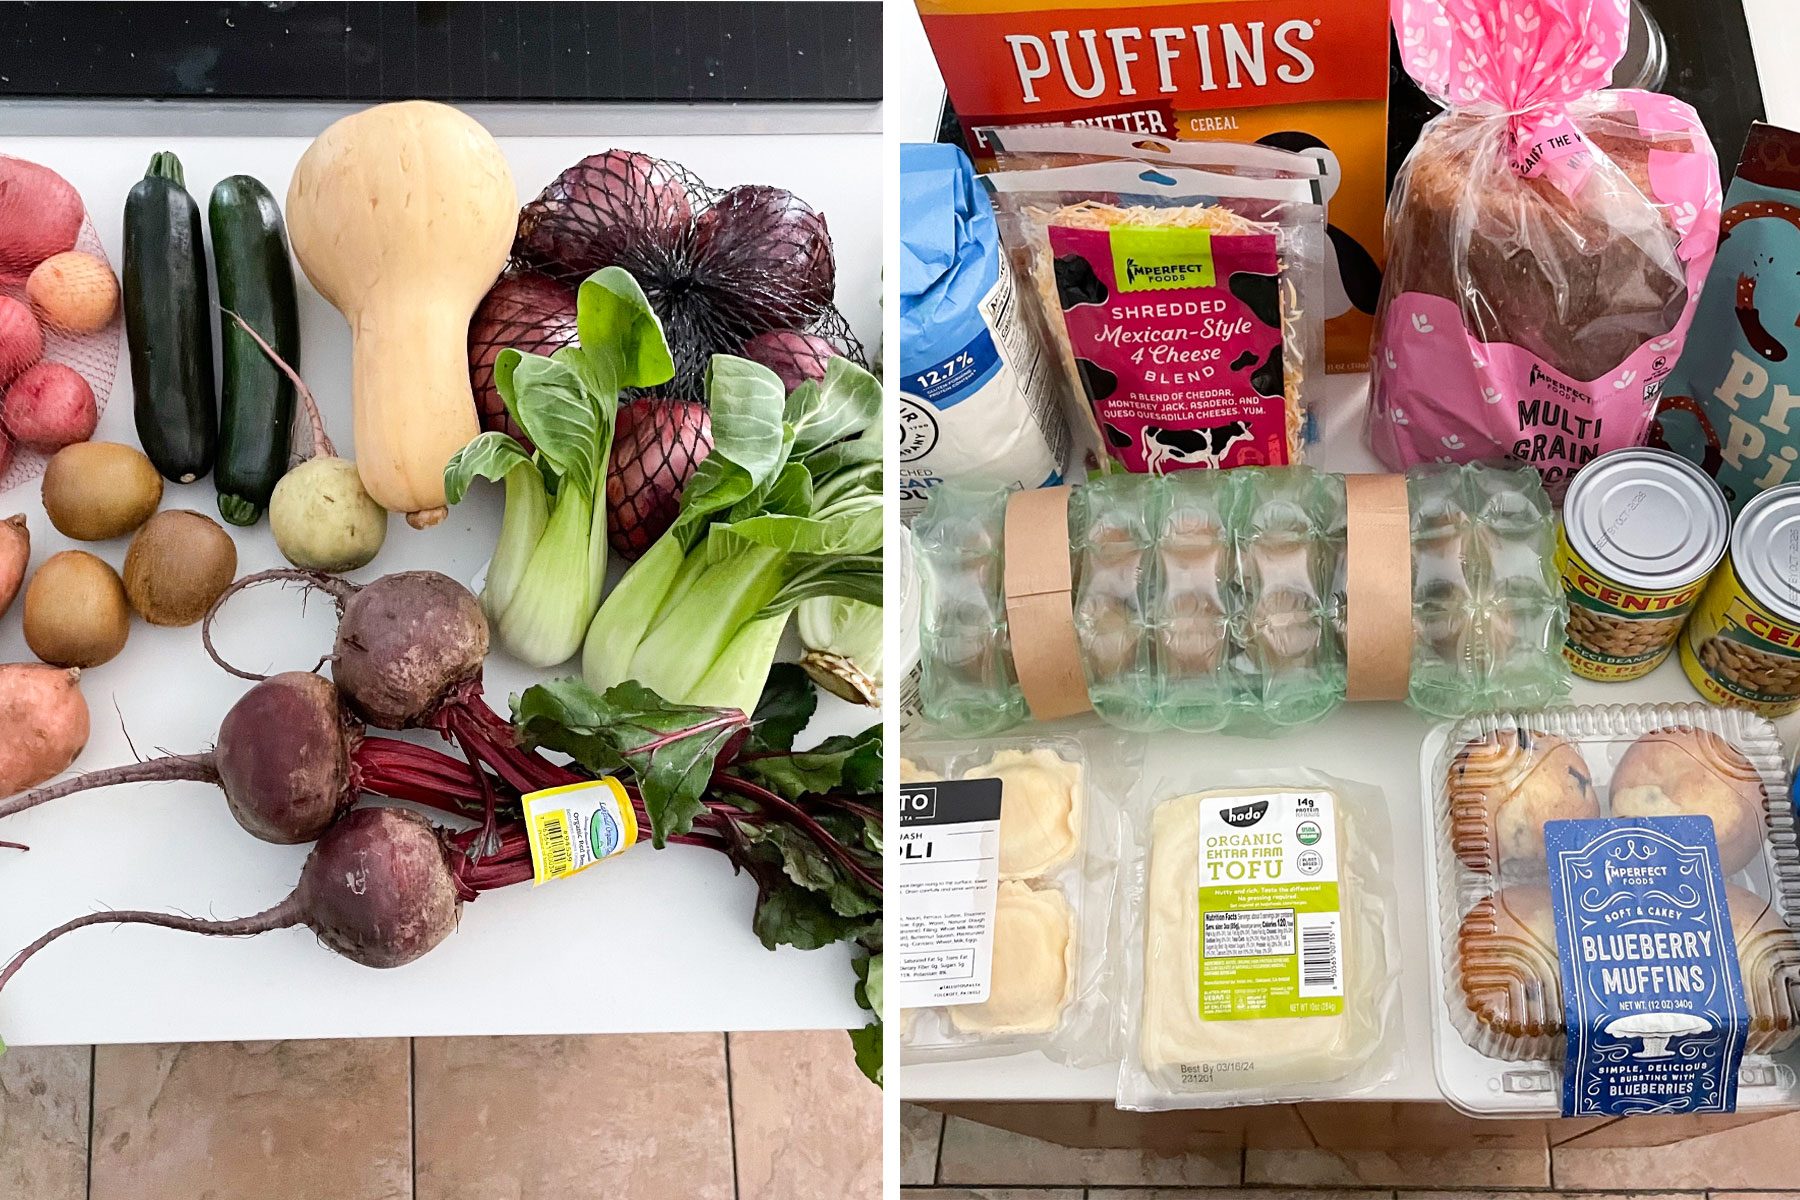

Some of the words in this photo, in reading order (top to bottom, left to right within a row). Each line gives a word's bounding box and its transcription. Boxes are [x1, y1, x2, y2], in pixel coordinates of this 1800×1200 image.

[1005, 20, 1315, 103] PUFFINS
[1190, 116, 1239, 132] CEREAL
[1548, 134, 1572, 148] THE
[1148, 274, 1185, 282] FOODS
[1112, 300, 1226, 319] SHREDDED
[1094, 317, 1252, 347] Mexican-Style
[1130, 348, 1144, 365] 4
[1149, 345, 1221, 364] Cheese
[917, 351, 974, 388] 12.7%
[1144, 366, 1214, 384] BLEND
[929, 386, 952, 398] PROTEIN
[1130, 392, 1137, 400] A
[1139, 392, 1170, 401] BLEND
[1172, 392, 1184, 400] OF
[1547, 384, 1576, 403] FOODS
[1108, 400, 1158, 410] MONTEREY
[1240, 397, 1259, 405] AND
[1104, 410, 1135, 418] QUESO
[1137, 409, 1194, 420] QUESADILLA
[1518, 400, 1602, 440] MULTI
[1512, 434, 1600, 464] GRAIN
[1578, 574, 1696, 611] CENTO
[1574, 646, 1600, 662] CECI
[1606, 655, 1650, 664] BEANS
[1728, 684, 1758, 700] CECI
[1298, 798, 1314, 808] 14g
[1228, 807, 1261, 822] hodo
[573, 812, 582, 838] Organic
[1206, 833, 1282, 848] ORGANIC
[900, 842, 932, 859] LI
[1206, 848, 1248, 860] EXTRA
[1252, 847, 1283, 858] FIRM
[1208, 860, 1284, 880] TOFU
[1226, 912, 1237, 920] Facts
[1604, 910, 1631, 922] SOFT
[1636, 907, 1644, 916] &
[1648, 908, 1682, 920] CAKEY
[1582, 931, 1712, 962] BLUEBERRY
[1602, 966, 1705, 995] MUFFINS
[1619, 1002, 1633, 1010] NET
[1634, 1001, 1646, 1010] WT.
[1648, 1000, 1660, 1010] (12
[1661, 1000, 1674, 1010] OZ)
[1675, 1000, 1692, 1010] 340g
[1180, 1064, 1200, 1073] Best
[1202, 1064, 1214, 1074] By
[1216, 1062, 1254, 1072] 03/16/24
[1598, 1065, 1642, 1074] SIMPLE,
[1648, 1062, 1708, 1072] DELICIOUS
[1182, 1074, 1214, 1083] 231201
[1620, 1074, 1670, 1082] BURSTING
[1672, 1073, 1695, 1081] WITH
[1609, 1082, 1694, 1096] BLUEBERRIES
